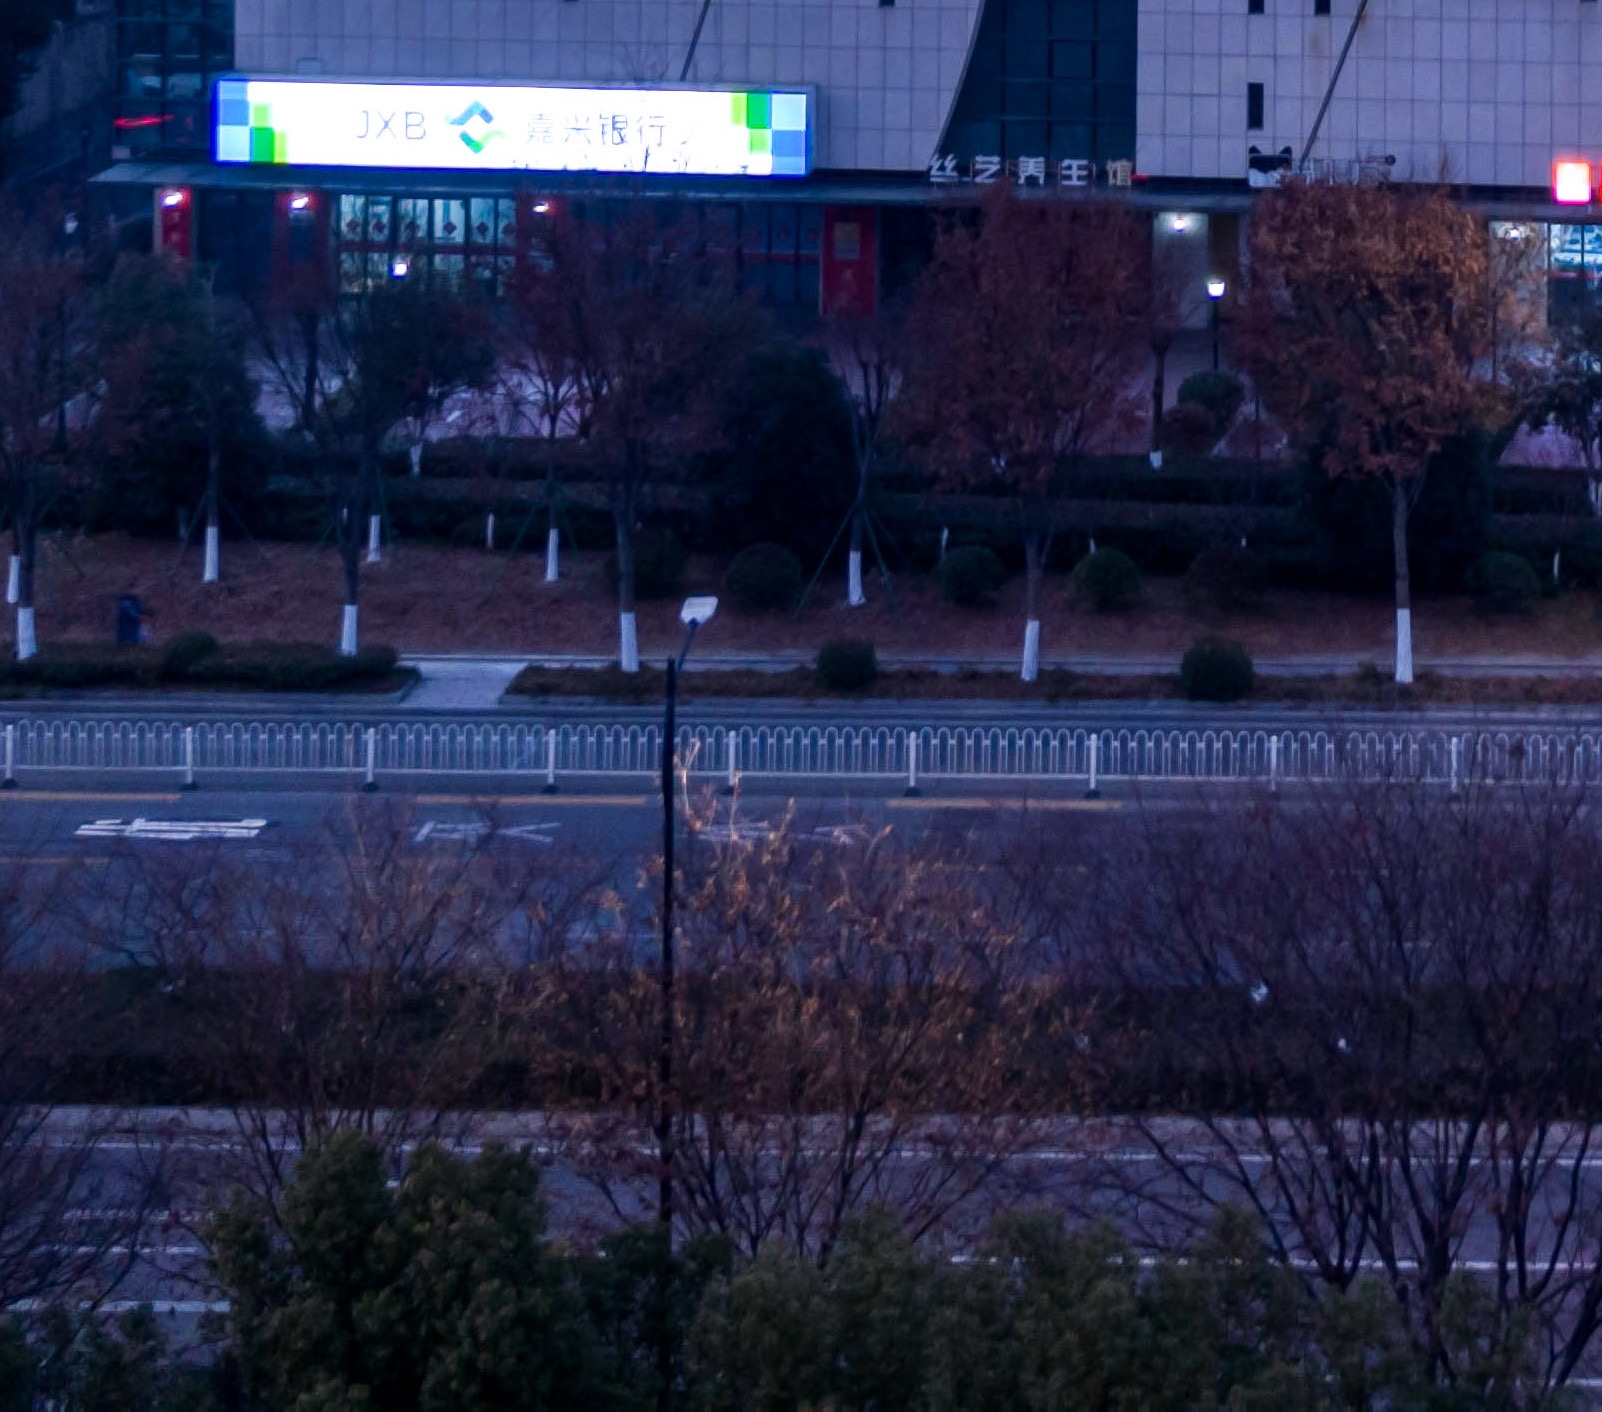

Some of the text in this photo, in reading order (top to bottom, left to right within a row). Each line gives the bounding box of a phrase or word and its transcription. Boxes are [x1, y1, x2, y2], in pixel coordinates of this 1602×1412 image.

[356, 110, 427, 140] JXB
[525, 112, 668, 147] 嘉兴银行
